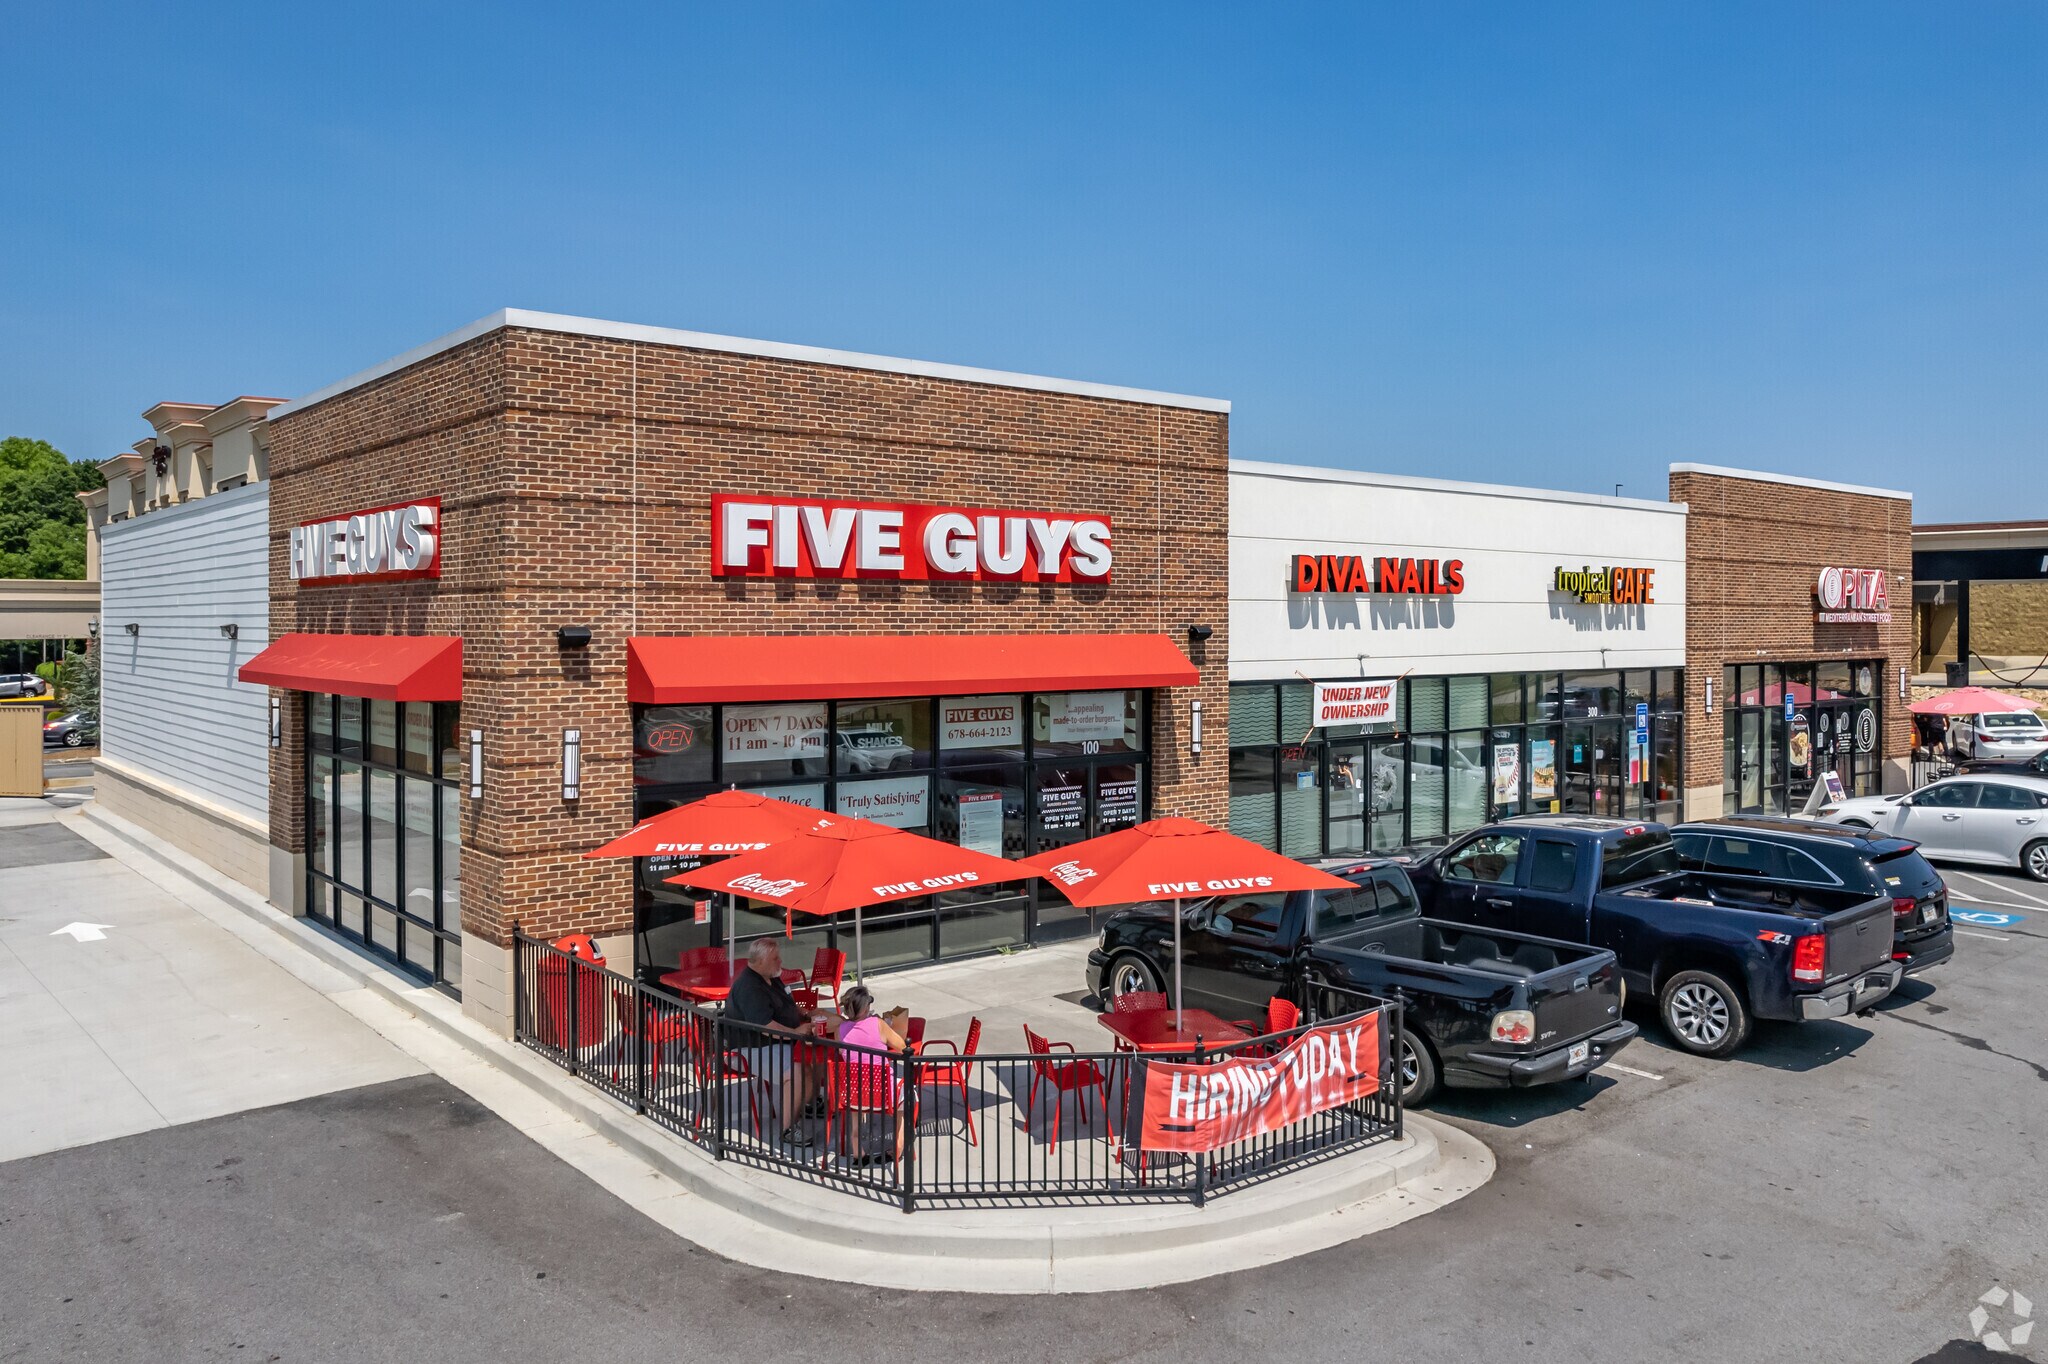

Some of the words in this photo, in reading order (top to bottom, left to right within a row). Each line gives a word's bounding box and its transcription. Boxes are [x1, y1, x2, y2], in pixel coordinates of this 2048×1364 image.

[290, 520, 347, 579] FIVE
[346, 505, 434, 575] GUYS
[722, 502, 904, 569] FIVE
[924, 512, 1112, 577] GUYS
[1291, 555, 1370, 592] DIVA
[1374, 557, 1464, 594] NAILS
[1555, 566, 1611, 596] tropical
[1612, 567, 1655, 604] CAFE
[1584, 593, 1611, 604] SMOOTHIE
[1820, 612, 1862, 622] MEDITERRANEAN
[1862, 612, 1879, 622] STREET
[1879, 613, 1892, 622] FOOD
[1322, 688, 1362, 702] UNDER
[1364, 686, 1391, 699] NEW
[946, 710, 975, 722] FIVE
[978, 708, 1013, 721] GUYS
[1321, 702, 1389, 720] OWNERSHIP
[1588, 706, 1598, 717] 300
[726, 717, 769, 733] OPEN
[774, 716, 781, 731] 7
[787, 716, 824, 731] DAYS
[1053, 715, 1095, 726] made-to-order
[866, 722, 894, 734] MILK
[948, 726, 1012, 740] 678-664-2123
[1360, 723, 1374, 735] 200
[647, 729, 694, 748] OPEN
[728, 737, 741, 751] 11
[747, 738, 768, 750] am
[783, 735, 796, 748] 10
[801, 734, 821, 751] pm
[857, 735, 904, 749] SHAKES
[1081, 740, 1100, 755] 100
[1042, 794, 1059, 802] FIVE
[1061, 791, 1081, 800] GUYS
[1101, 789, 1117, 797] FIVE
[1118, 786, 1137, 795] GUYS
[778, 796, 812, 807] Place
[655, 843, 704, 852] FIVE
[708, 842, 768, 851] GUYS
[650, 854, 672, 863] OPEN
[679, 861, 688, 869] 10
[689, 861, 701, 869] pm
[872, 881, 924, 897] FIVE
[922, 872, 979, 888] GUYS
[1148, 882, 1203, 895] FIVE
[1207, 876, 1274, 890] GUYS
[1540, 1031, 1552, 1040] SVT
[1169, 1063, 1278, 1121] HIRING
[1279, 1025, 1363, 1095] TODAY
